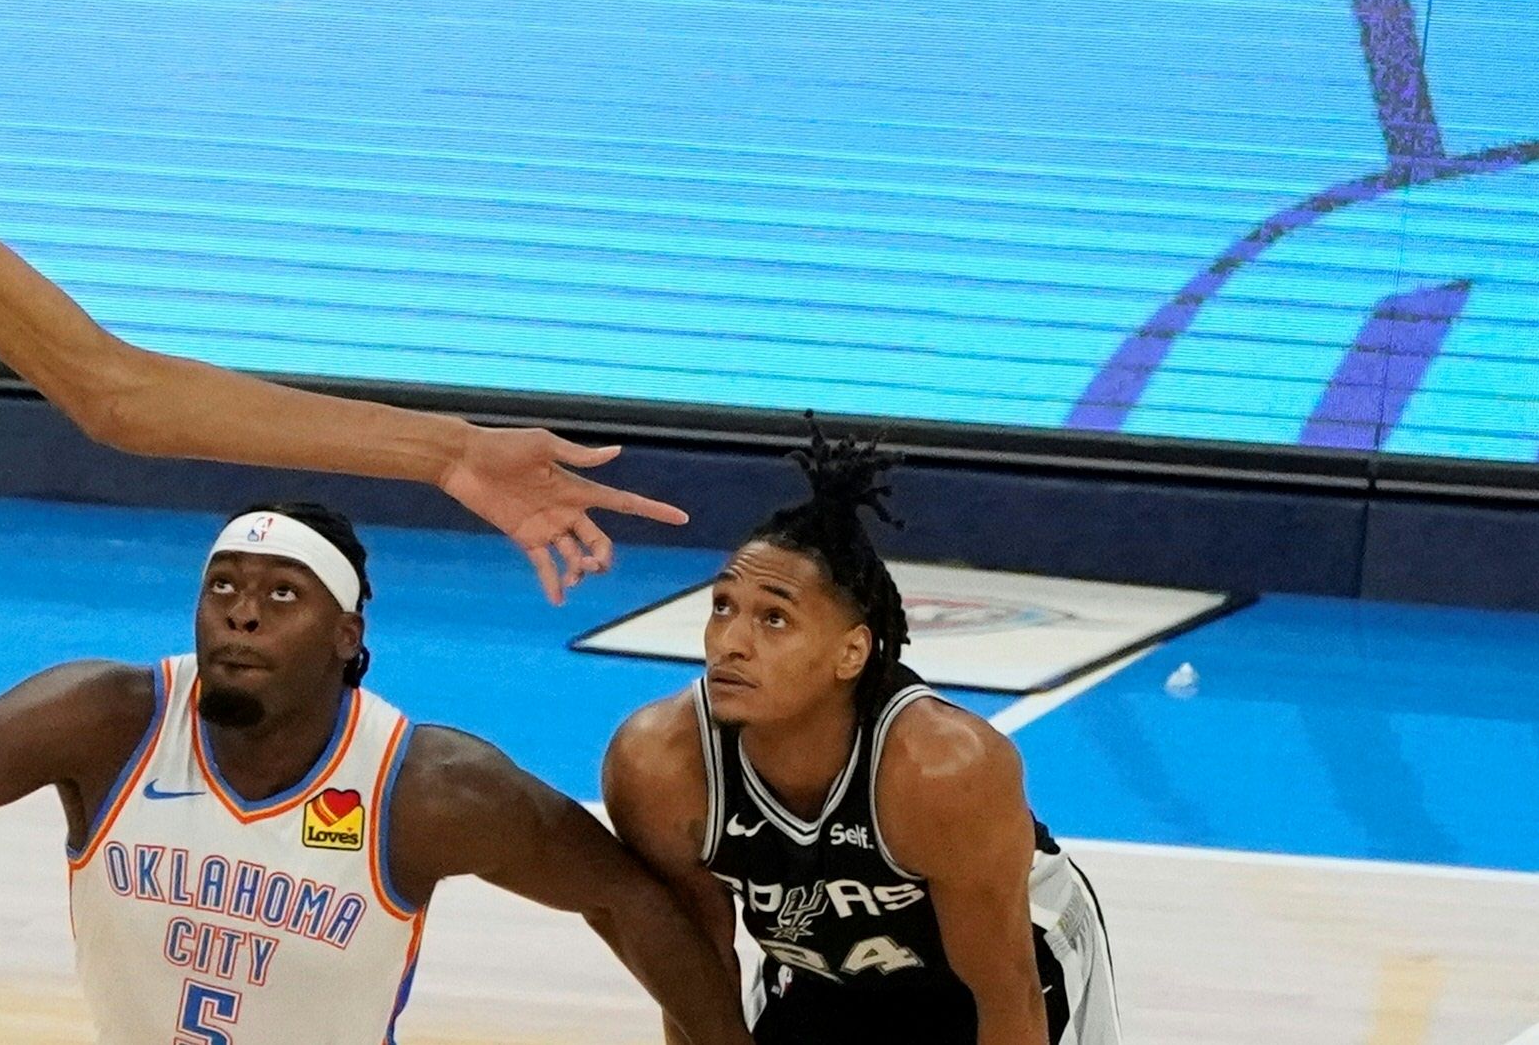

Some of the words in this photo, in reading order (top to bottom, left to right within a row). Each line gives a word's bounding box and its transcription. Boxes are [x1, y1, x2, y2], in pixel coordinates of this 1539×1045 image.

[104, 841, 367, 950] OKLAHOMA
[164, 917, 279, 987] CITY
[174, 978, 242, 1045] 5
